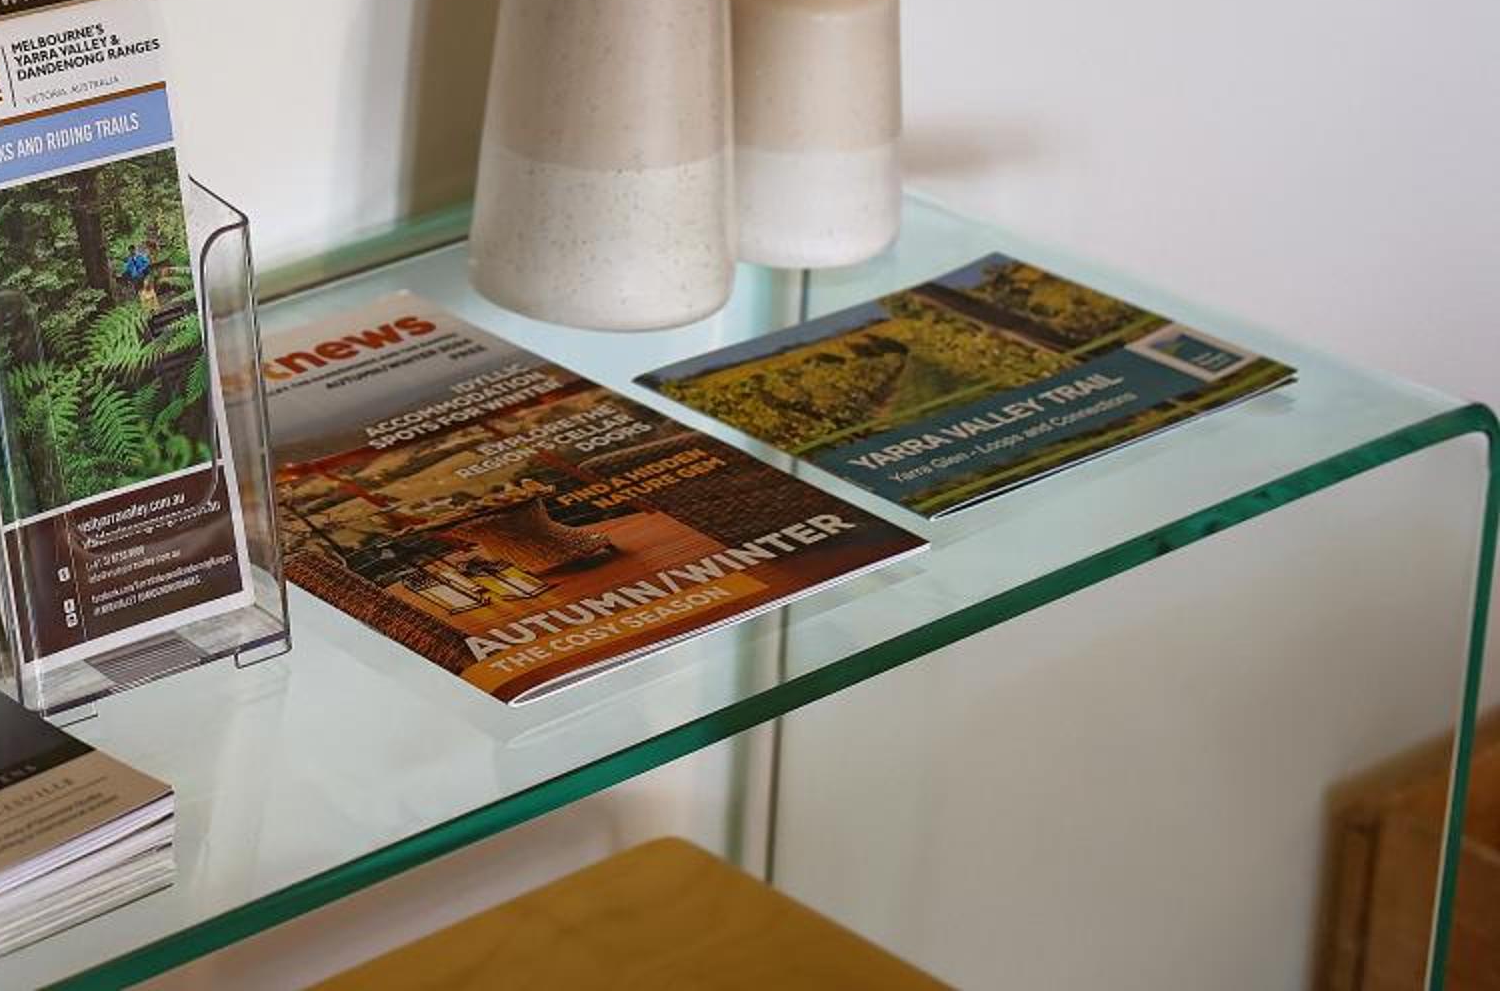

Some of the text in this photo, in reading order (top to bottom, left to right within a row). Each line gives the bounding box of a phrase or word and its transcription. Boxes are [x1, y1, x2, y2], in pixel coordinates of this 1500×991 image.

[11, 23, 105, 54] MELBOURNE'S
[14, 34, 120, 67] YARRA VALLEY &
[16, 38, 162, 82] DANDENONG RANGES
[70, 75, 120, 94] AUSTRALIA
[17, 138, 44, 159] AND
[47, 127, 94, 151] RIDING
[94, 112, 141, 139] TRAILS
[364, 369, 548, 437] ACCOMMODATION
[367, 376, 566, 450] SPOTS FOR WINTER
[556, 412, 636, 446] CELLAR
[848, 373, 1125, 471] YARRA VALLEY TRAIL
[475, 403, 617, 457] EXPLORE THE
[575, 420, 653, 454] DOORS
[888, 464, 933, 484] Yarra
[931, 449, 971, 469] Glen
[975, 433, 1025, 455] Loops
[1024, 420, 1052, 439] and
[557, 448, 711, 507] FIND A HIDDEN
[592, 456, 728, 509] NATURE GEM
[463, 513, 858, 663] AUTUMN/WINTER
[489, 584, 734, 675] THE COSY SEASON
